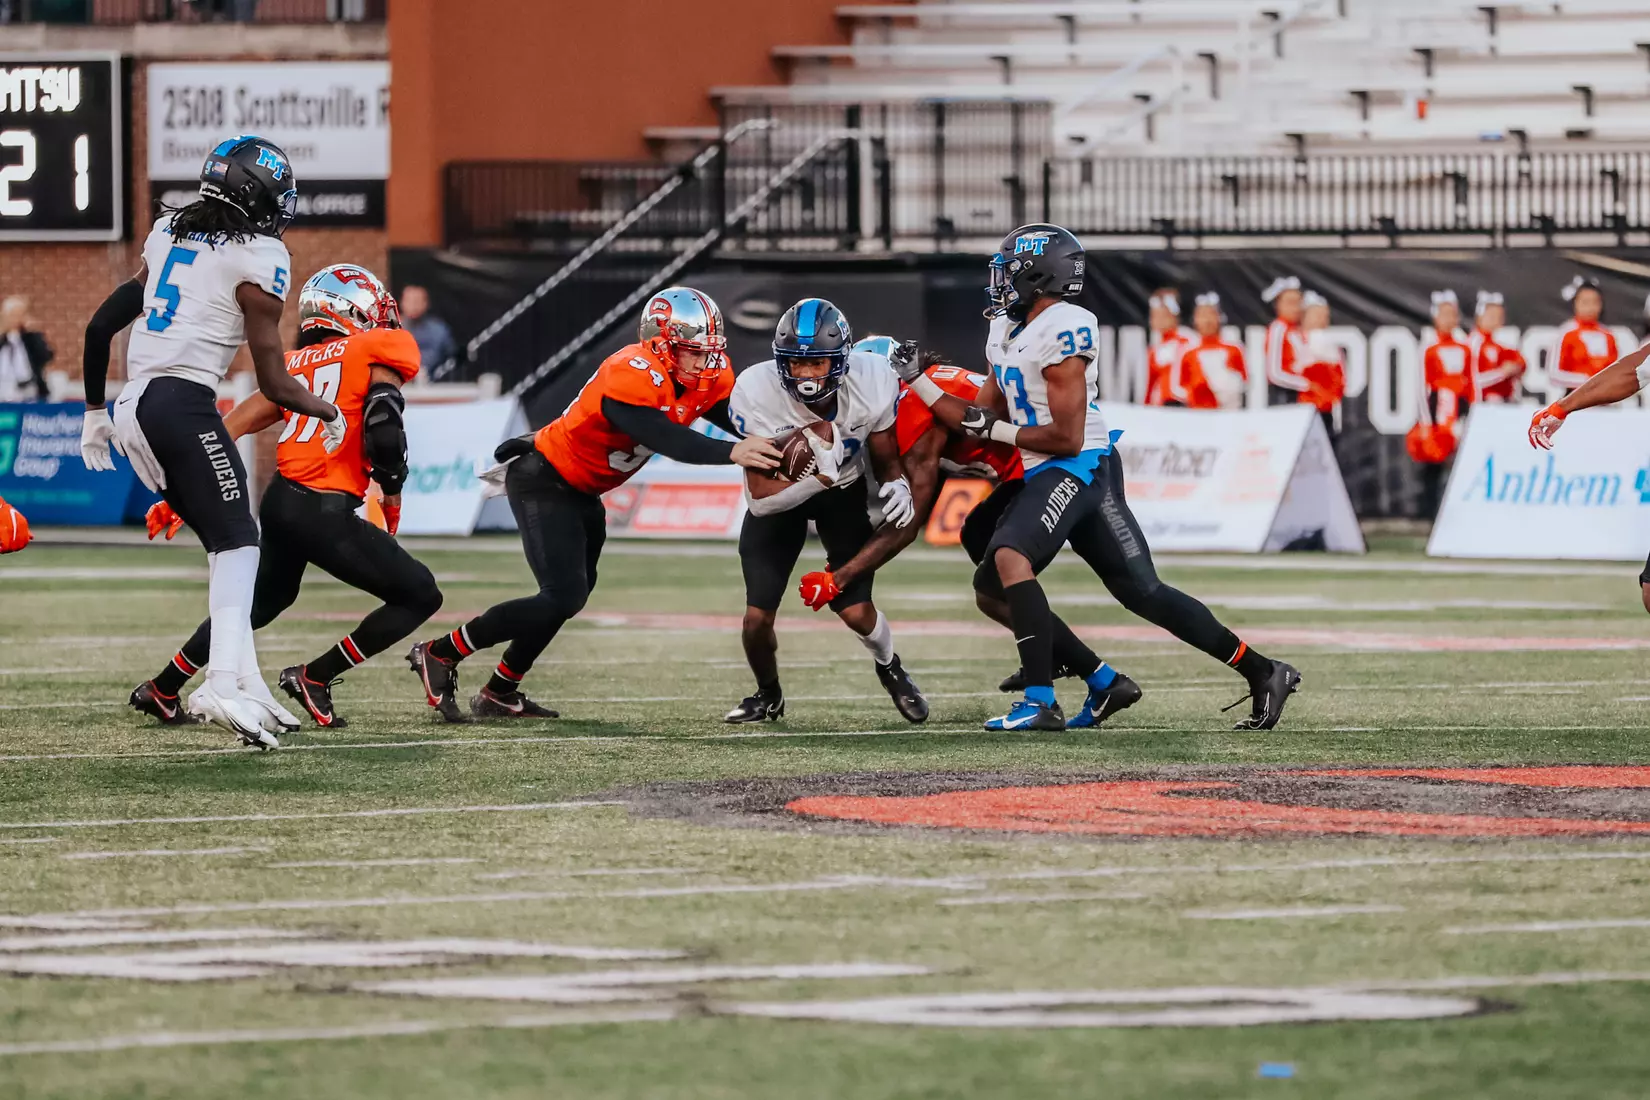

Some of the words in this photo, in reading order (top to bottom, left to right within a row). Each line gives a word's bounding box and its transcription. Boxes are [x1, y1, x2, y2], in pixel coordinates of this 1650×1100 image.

[163, 86, 224, 129] 2508
[234, 86, 366, 129] Scottsville
[1014, 236, 1050, 256] MT
[146, 246, 199, 332] 5
[272, 267, 288, 294] 5
[286, 340, 348, 372] MYERS
[1057, 327, 1093, 356] 33
[628, 356, 665, 387] 54
[198, 430, 241, 502] RAIDERS
[1464, 452, 1622, 506] Anthem
[1041, 477, 1079, 534] RAIDERS
